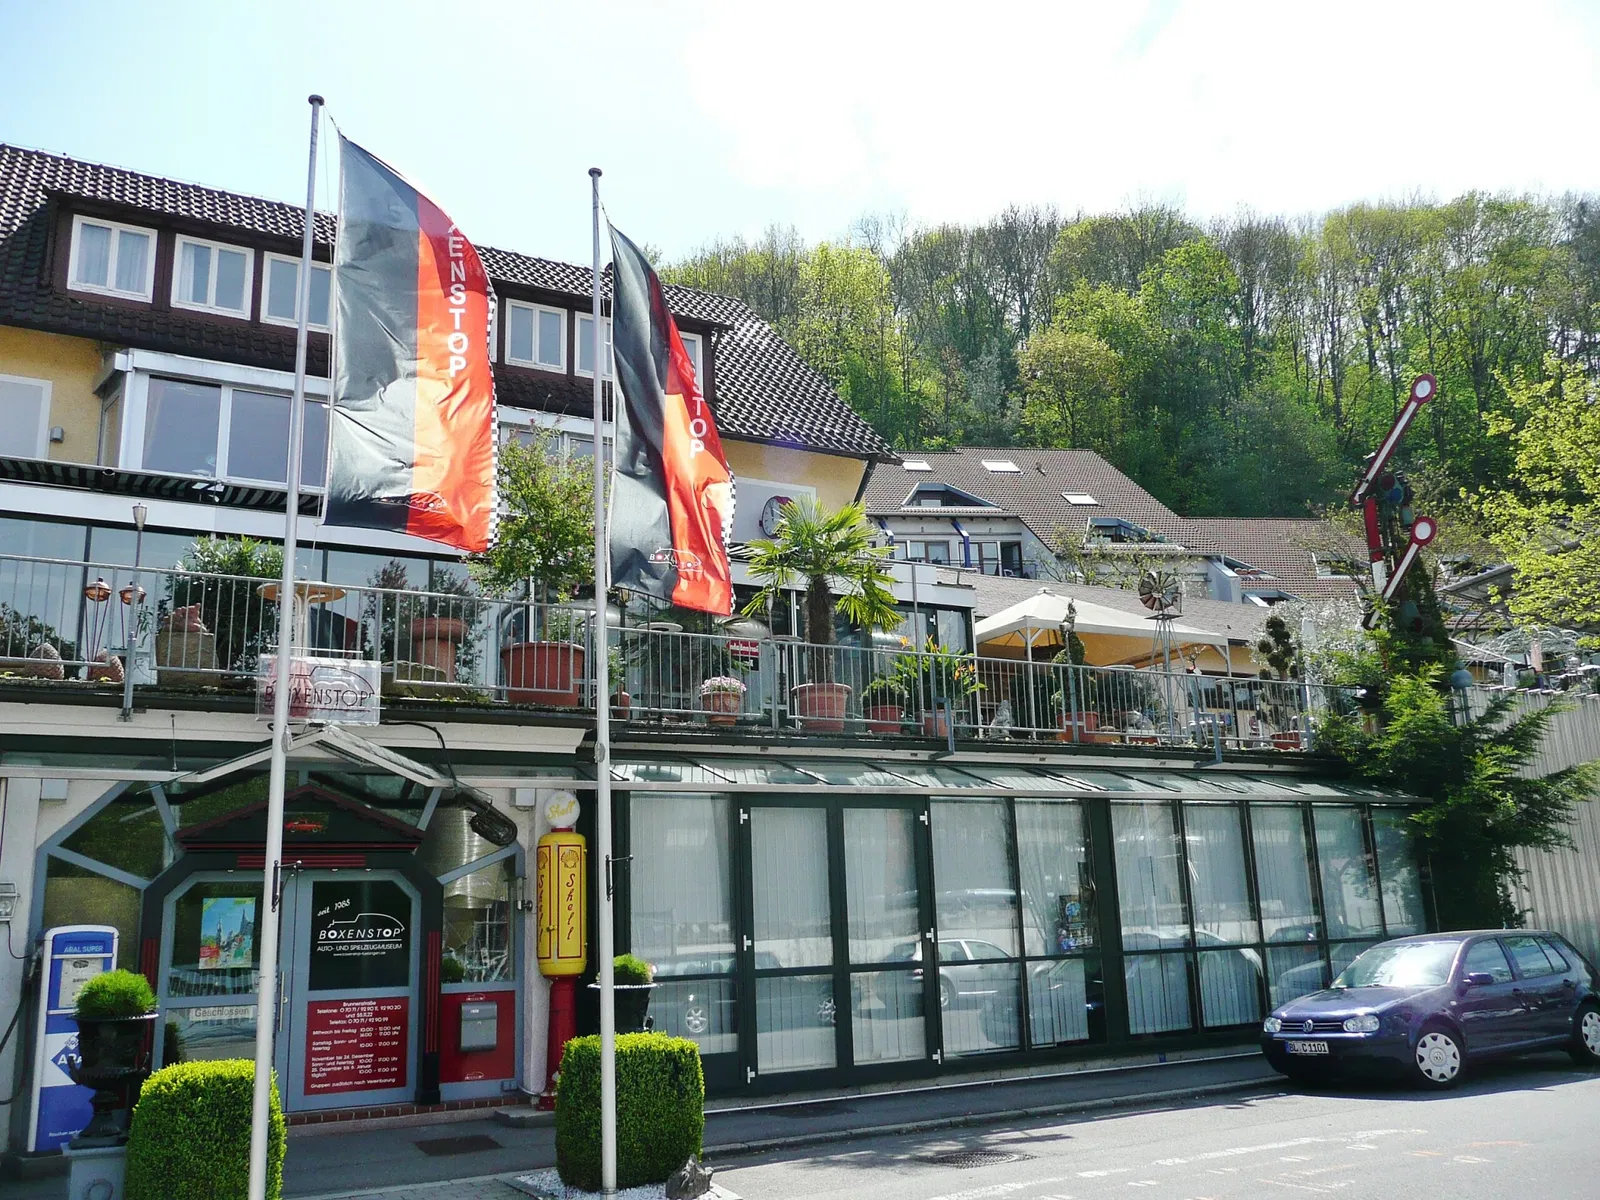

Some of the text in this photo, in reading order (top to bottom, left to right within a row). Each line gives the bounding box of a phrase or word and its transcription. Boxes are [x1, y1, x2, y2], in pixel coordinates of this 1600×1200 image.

[264, 685, 369, 706] BXENSTOP
[566, 873, 576, 940] Shell
[319, 928, 401, 940] BOXENSTOP
[350, 943, 402, 951] SPIELZEUGMUSEUM
[194, 1007, 249, 1017] Geschlossen
